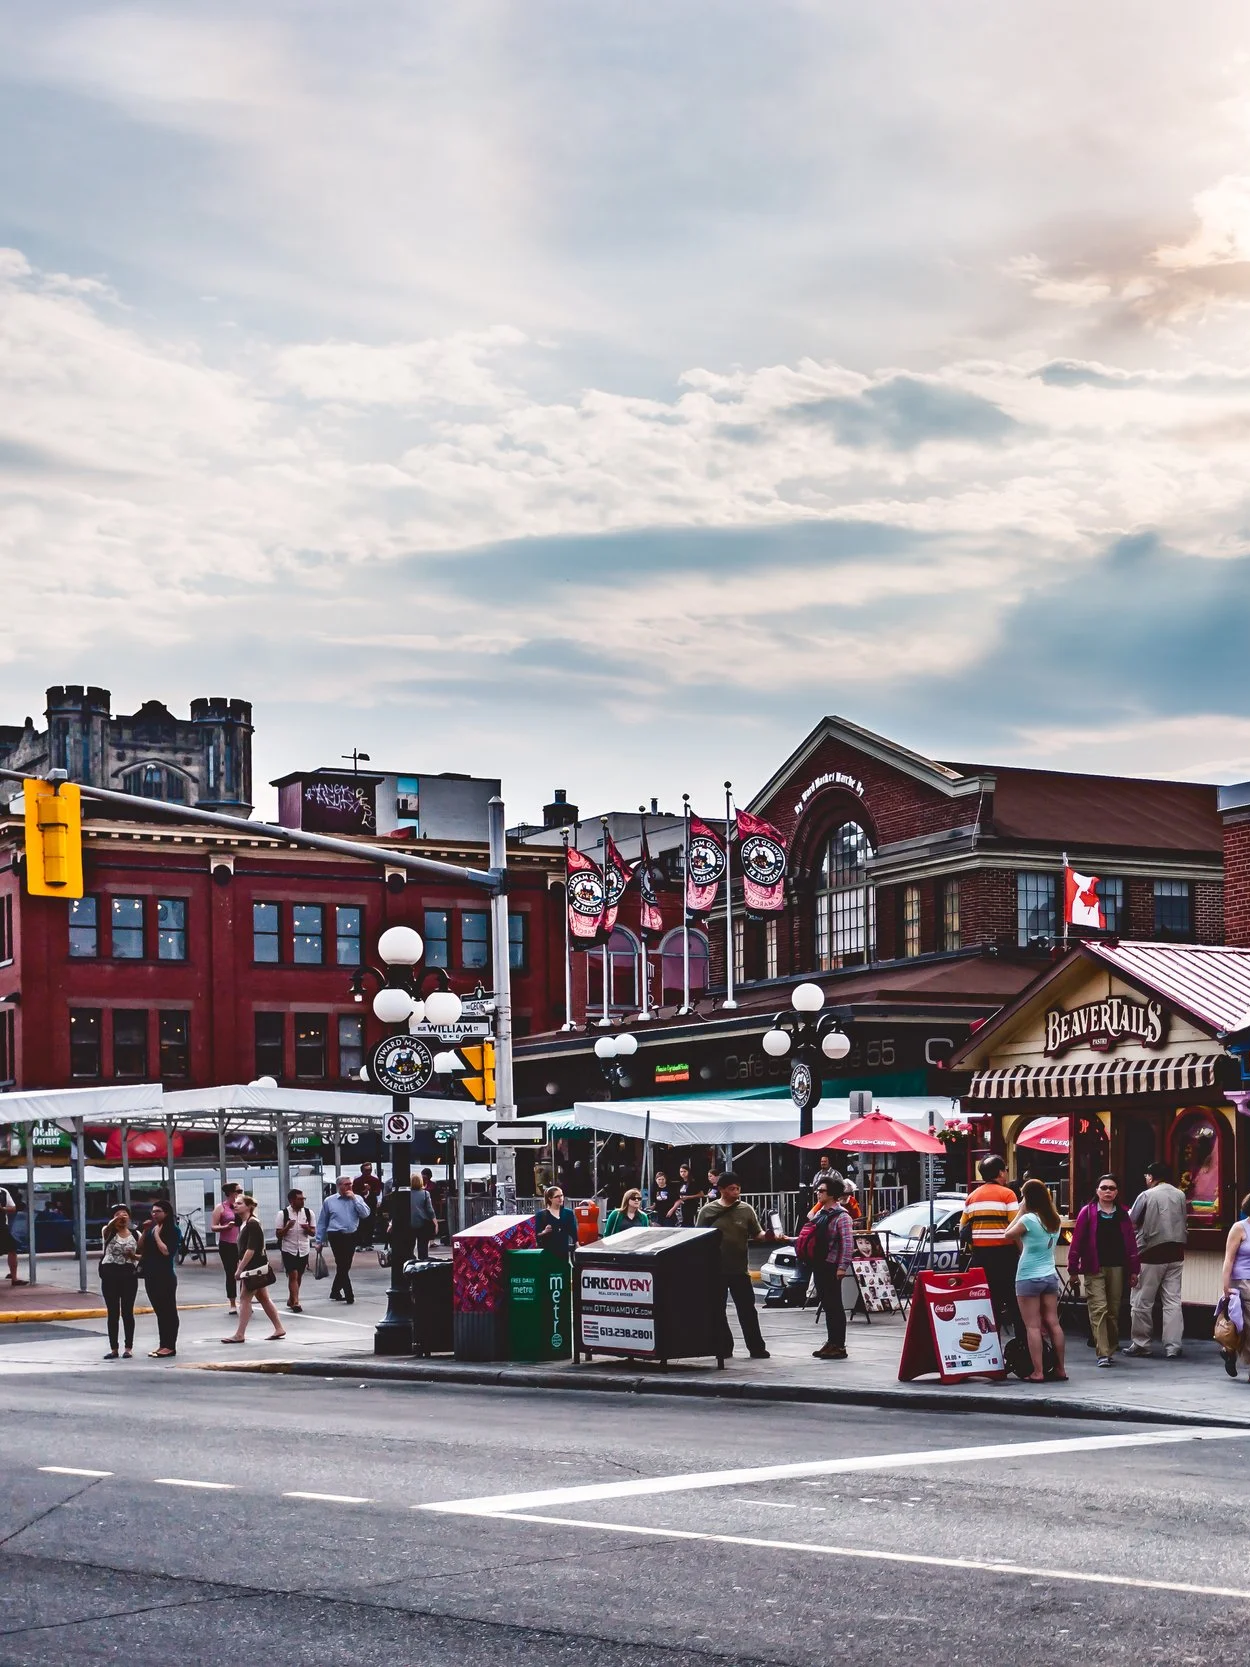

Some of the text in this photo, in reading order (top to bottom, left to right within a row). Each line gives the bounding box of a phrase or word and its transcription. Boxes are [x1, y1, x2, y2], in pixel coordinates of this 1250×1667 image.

[427, 1024, 473, 1034] WILLIAM
[377, 1040, 430, 1065] BYWARD MARKET
[866, 1039, 895, 1066] 55
[725, 1052, 764, 1080] Café
[381, 1075, 425, 1091] MARCHE BY
[33, 1137, 60, 1146] Corner
[926, 1252, 960, 1270] POL
[513, 1286, 534, 1294] metro
[969, 1289, 986, 1297] Coca-Cola
[935, 1303, 954, 1313] Coca-Cola
[600, 1326, 653, 1340] 613.238.2801
